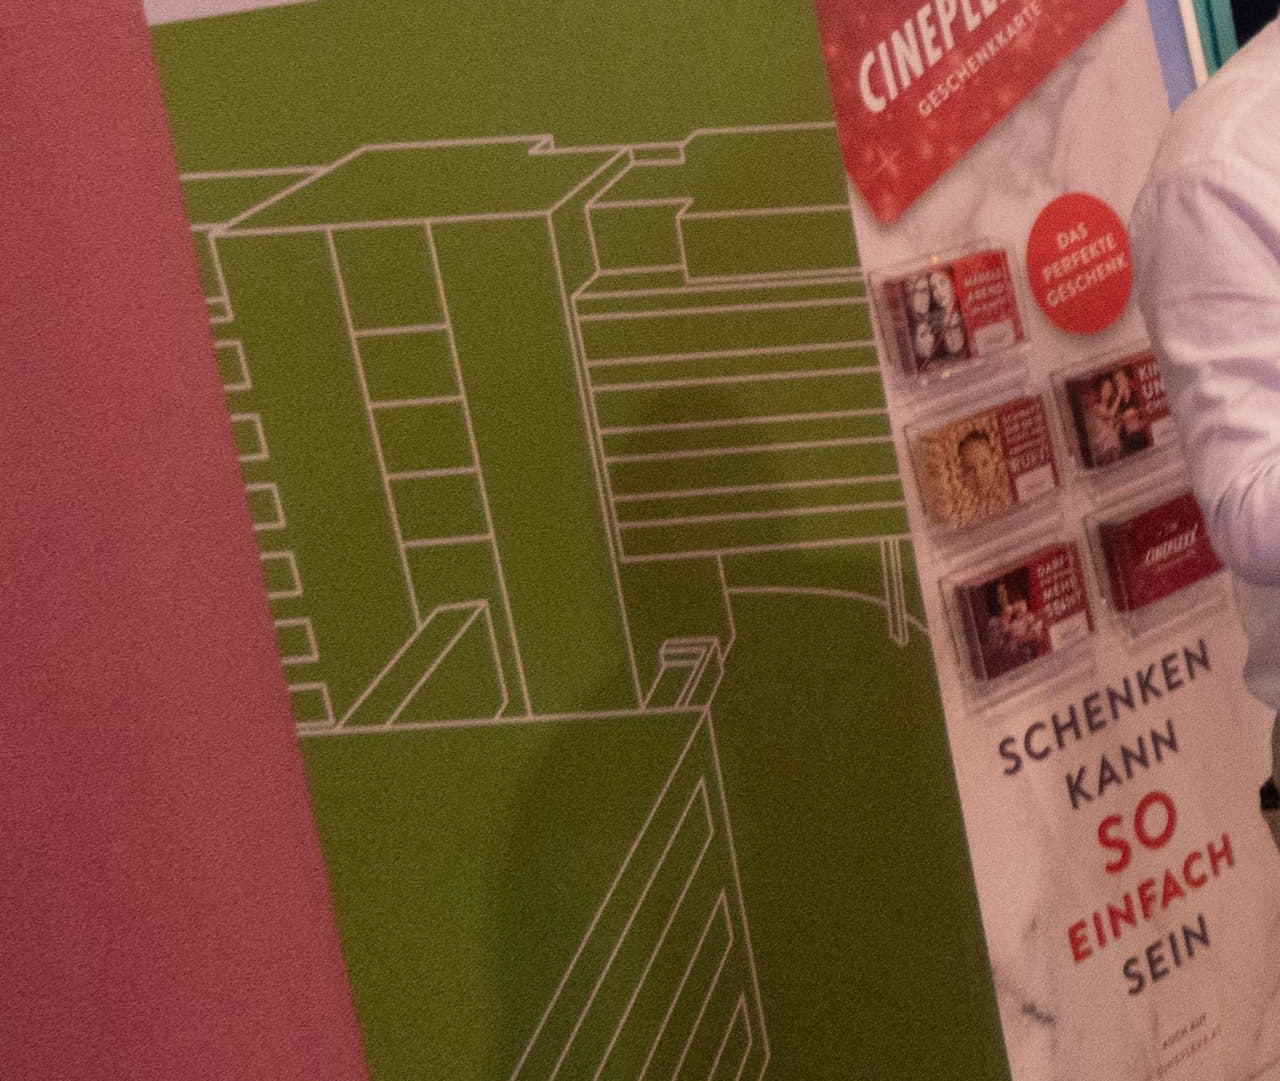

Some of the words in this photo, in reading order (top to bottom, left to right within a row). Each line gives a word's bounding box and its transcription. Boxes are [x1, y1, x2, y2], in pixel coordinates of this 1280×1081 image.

[918, 0, 1042, 117] GESCHENKKARTE
[1041, 238, 1117, 283] PERFEKTE
[1057, 224, 1089, 251] DAS
[1046, 255, 1129, 309] GESCHENK
[999, 639, 1211, 776] SCHENKEN
[1066, 720, 1179, 809] KANN
[1098, 791, 1177, 874] SO
[1067, 833, 1235, 963] EINFACH
[1122, 914, 1211, 996] SEIN
